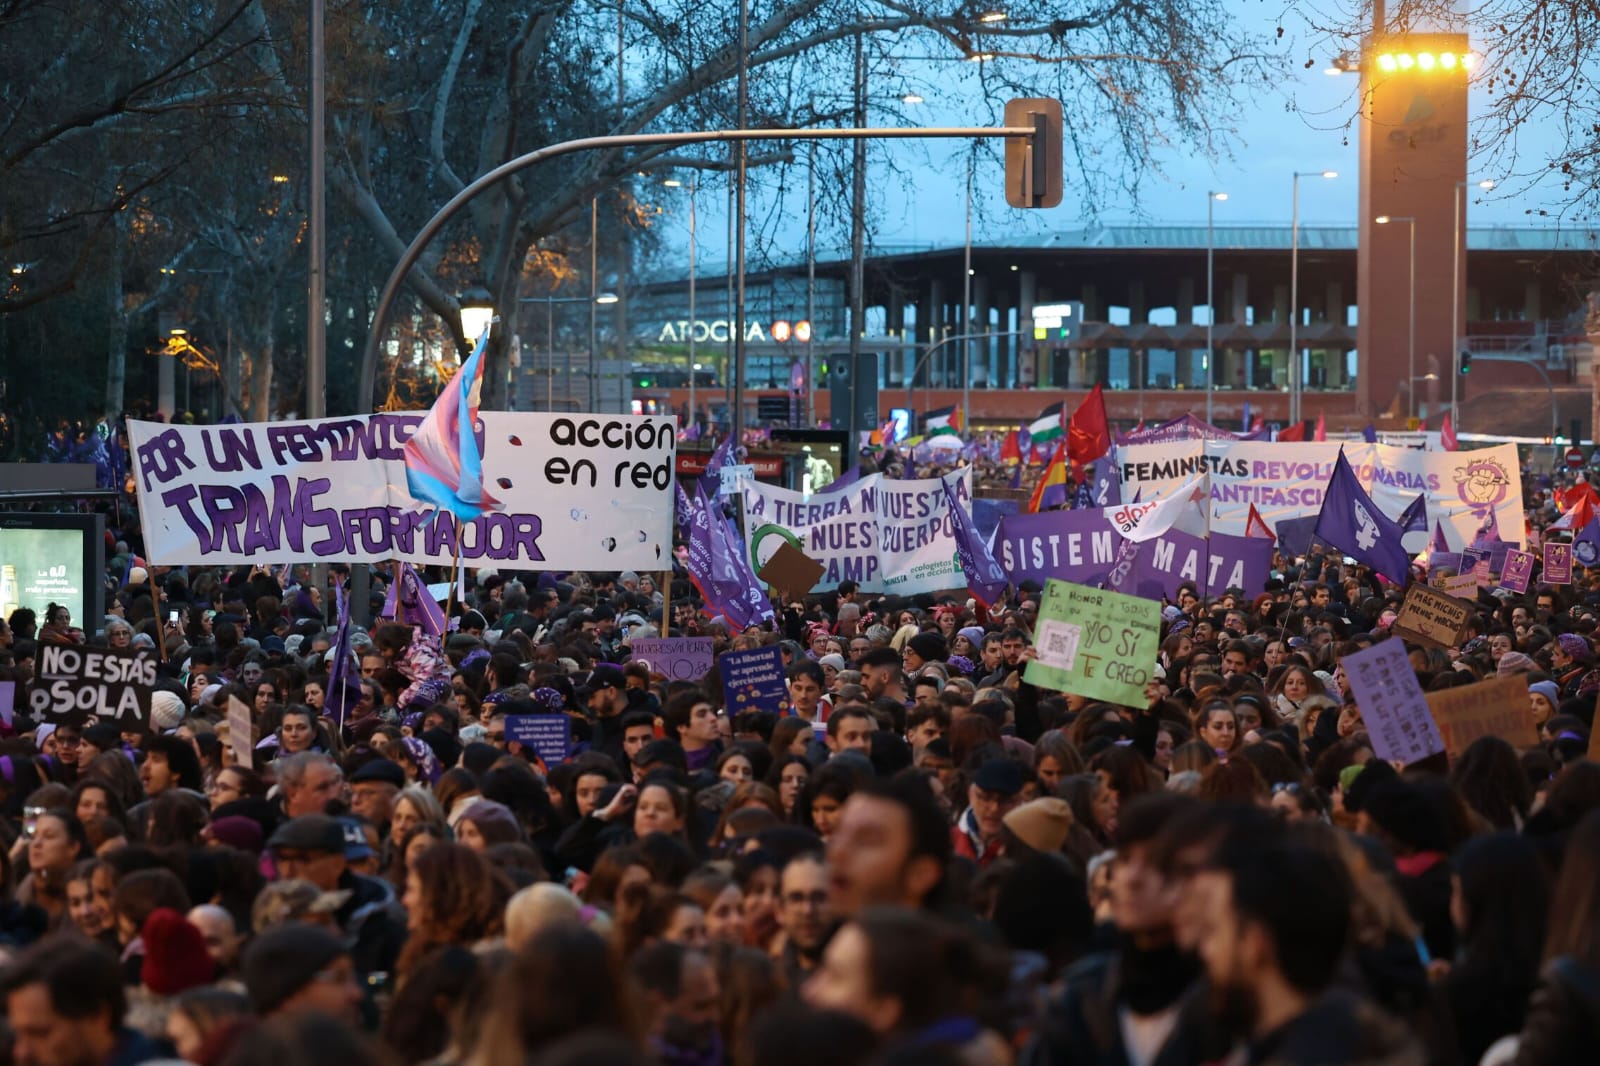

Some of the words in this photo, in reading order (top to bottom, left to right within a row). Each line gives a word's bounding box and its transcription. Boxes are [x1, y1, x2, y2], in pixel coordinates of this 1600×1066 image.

[549, 418, 674, 450] acción
[137, 428, 197, 493] POR
[201, 428, 263, 472] UN
[267, 414, 485, 466] FEMINIS
[544, 456, 597, 487] en
[614, 455, 671, 491] red
[1252, 460, 1441, 491] REVOLUIONARIAS
[745, 488, 765, 516] LA
[774, 494, 851, 528] TIERRA
[860, 487, 879, 514] N
[881, 476, 973, 519] VUESTA.
[1209, 483, 1324, 506] ANTIFASCI
[915, 571, 925, 580] en
[927, 566, 953, 578] acción
[1152, 535, 1245, 590] MATA
[1085, 620, 1113, 649] YO
[42, 646, 81, 674] NO
[84, 651, 157, 687] ESTÁS
[1105, 660, 1148, 687] CREO
[51, 680, 143, 720] SOLA
